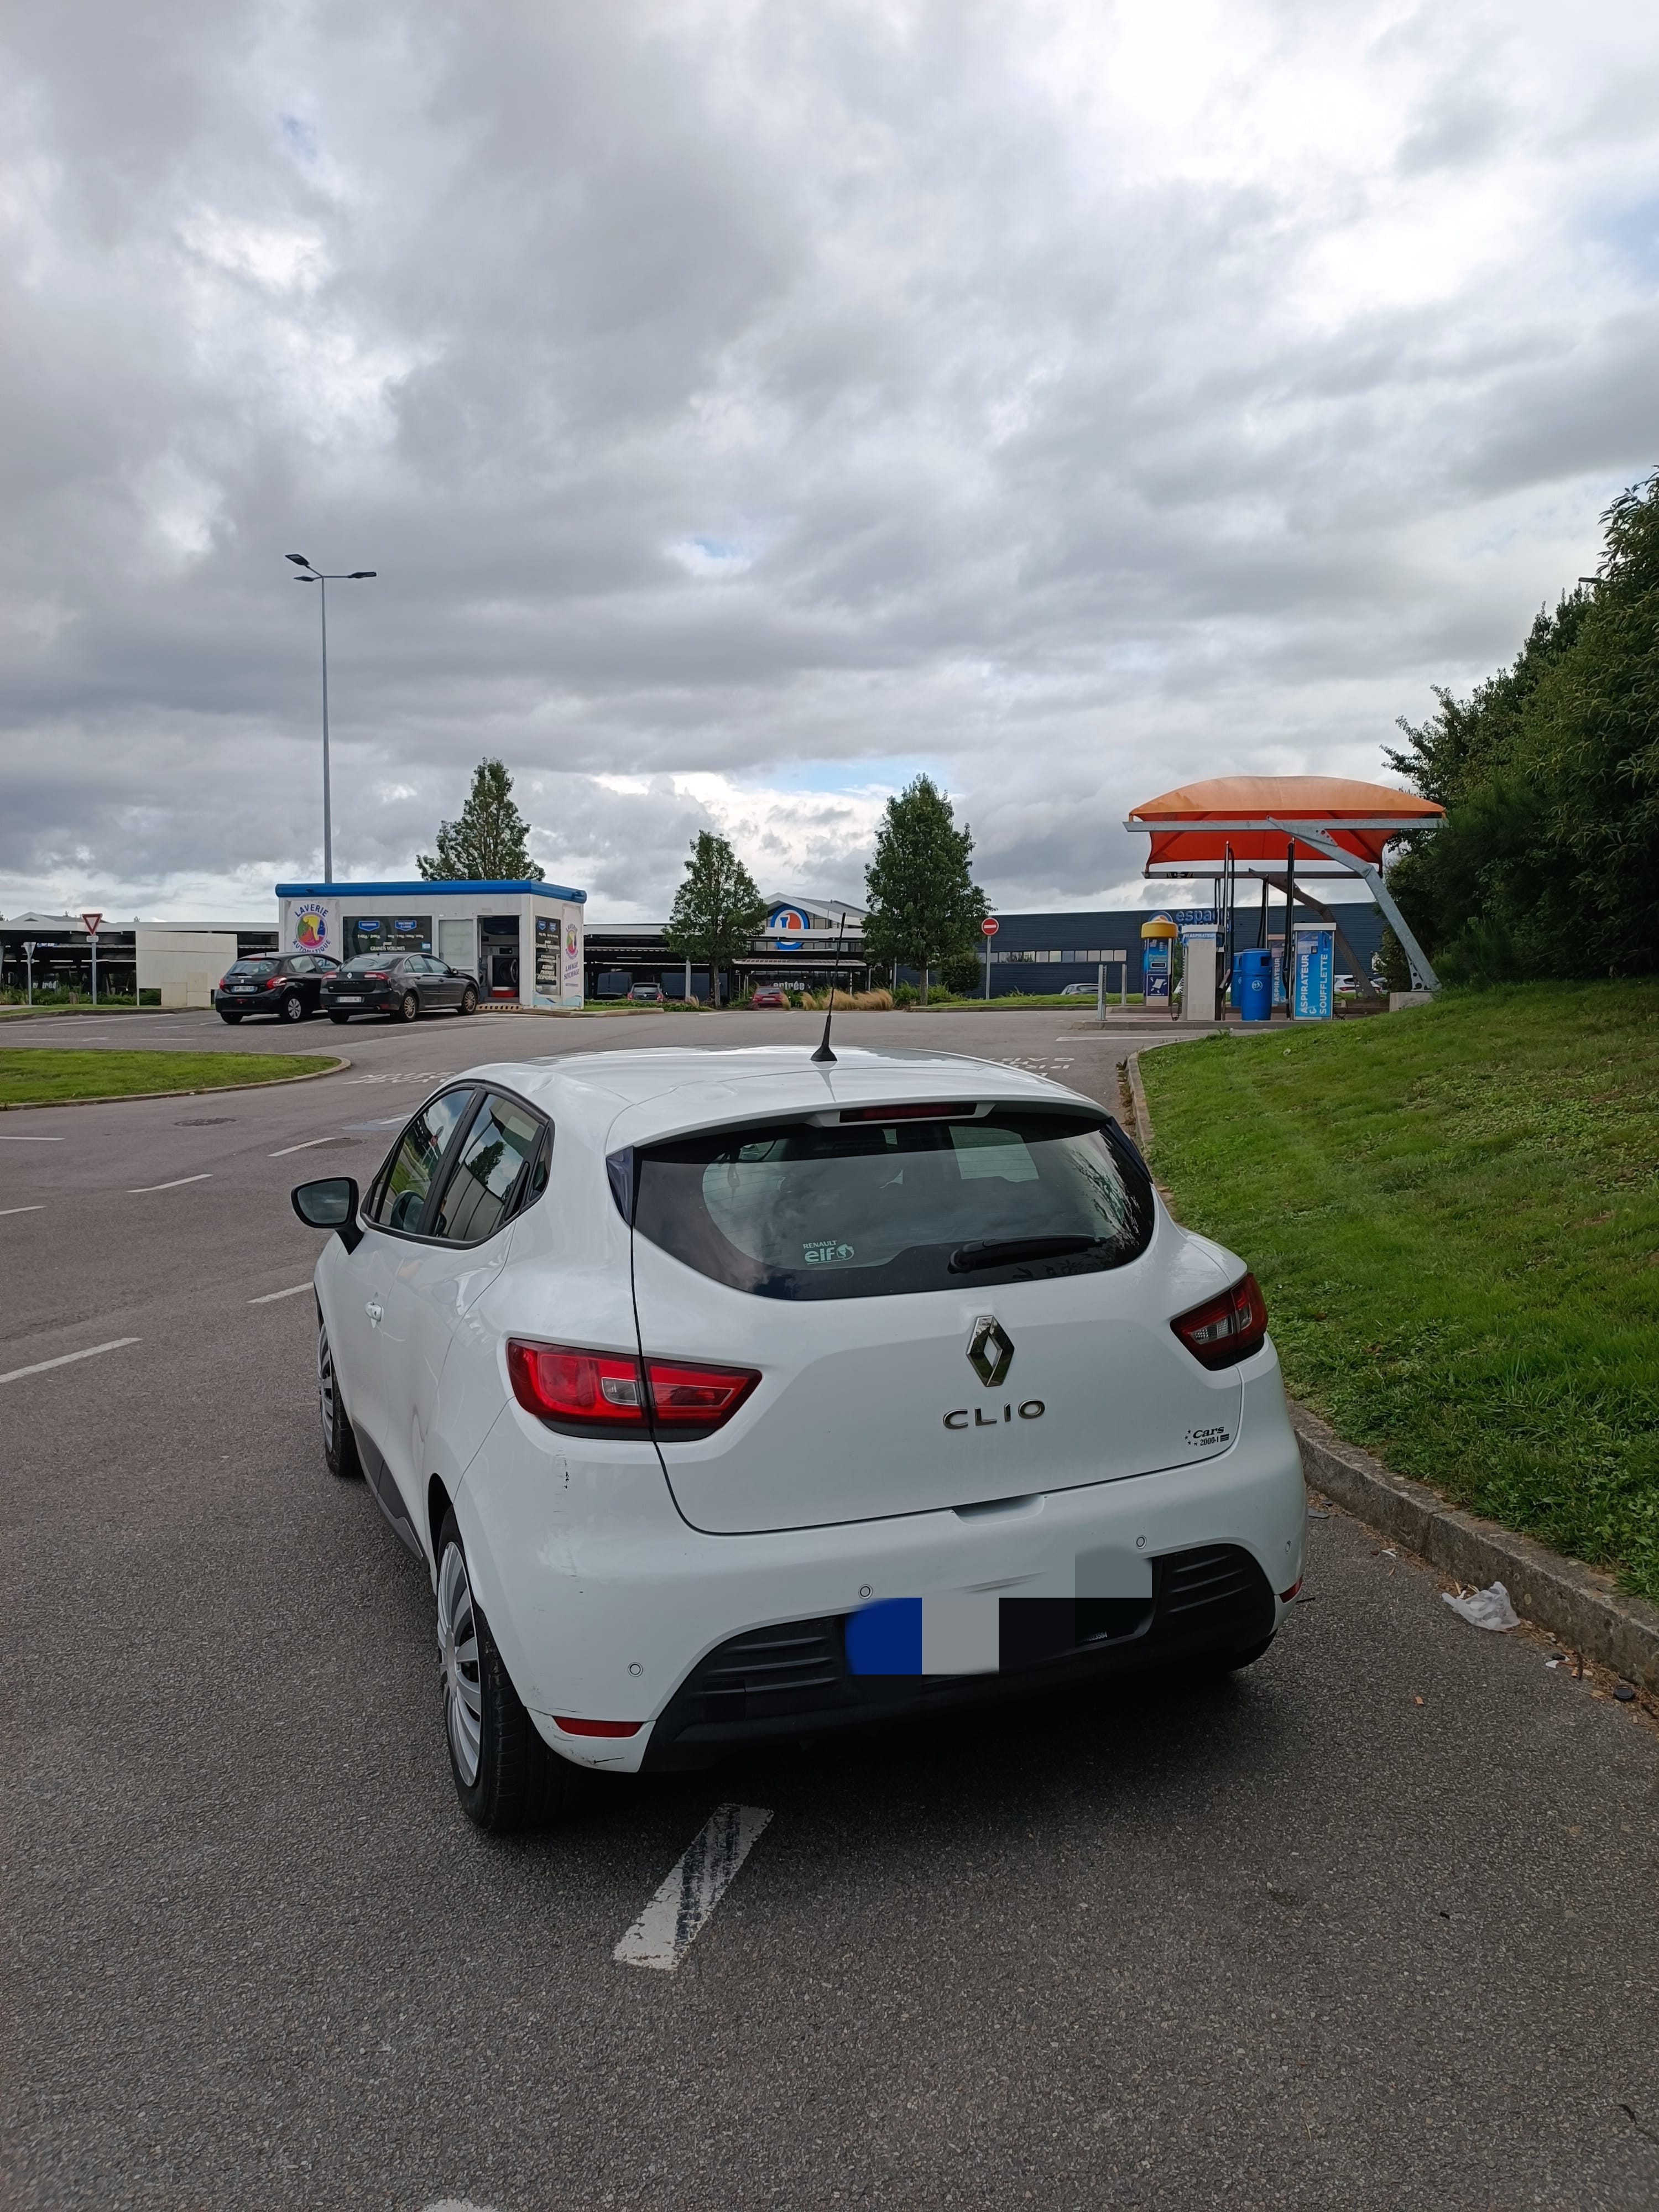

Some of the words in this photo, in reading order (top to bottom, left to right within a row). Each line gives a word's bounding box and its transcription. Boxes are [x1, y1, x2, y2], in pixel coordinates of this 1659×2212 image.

[295, 904, 329, 917] LAVERIE
[773, 980, 805, 990] entrée
[1301, 954, 1309, 1014] ASPIRATEUR
[1319, 954, 1328, 1014] SOUFFLETTE
[803, 1240, 837, 1249] RENAULT
[805, 1247, 835, 1262] elf
[942, 1399, 1045, 1430] CLIO
[1193, 1426, 1224, 1439] Cars
